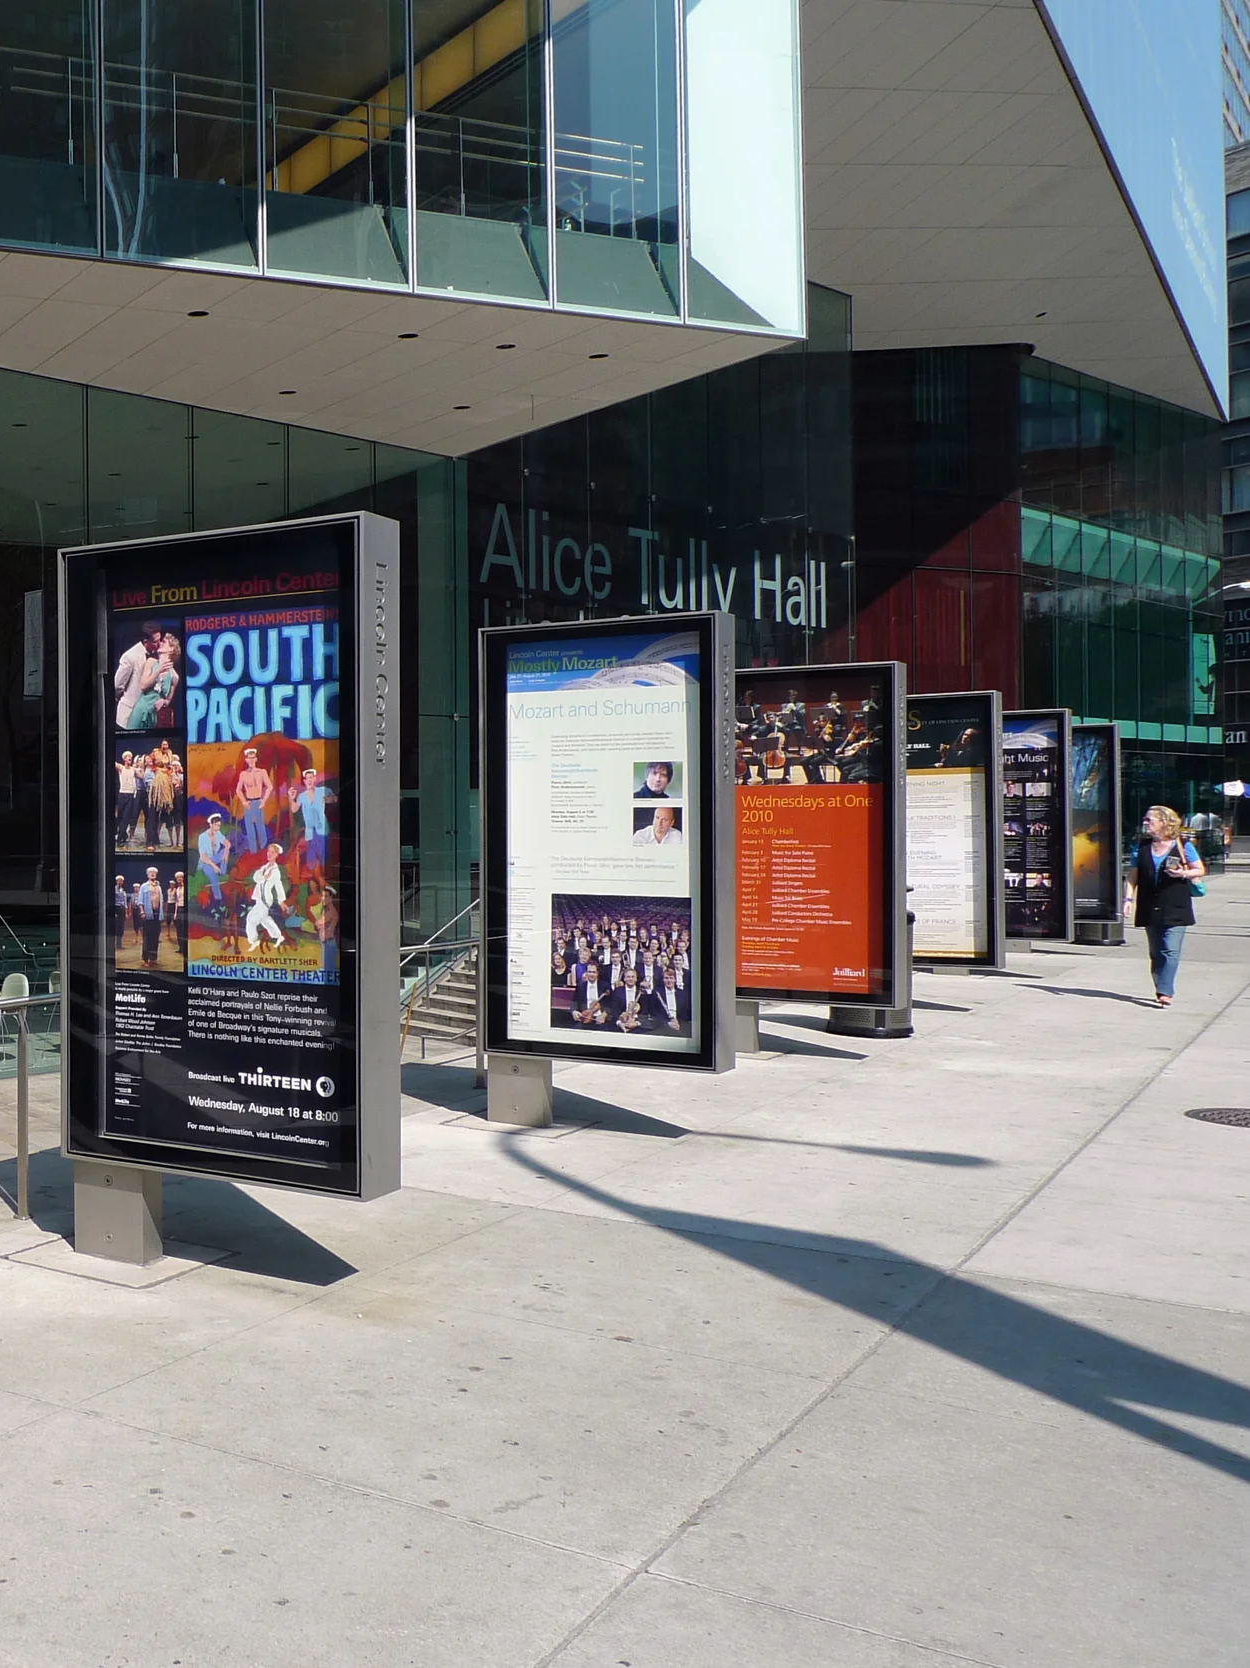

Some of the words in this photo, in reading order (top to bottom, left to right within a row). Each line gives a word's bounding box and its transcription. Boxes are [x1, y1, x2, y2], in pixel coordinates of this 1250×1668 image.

[479, 502, 612, 600] Alice
[628, 526, 737, 614] Tully
[754, 550, 827, 629] Hall
[112, 588, 147, 608] Live
[151, 585, 197, 604] From
[202, 576, 270, 600] Lincoln
[185, 615, 236, 632] RODGERS
[239, 615, 247, 626] &
[375, 562, 389, 666] Lincoln
[186, 622, 339, 687] SOUTH
[510, 658, 560, 675] Mostly
[562, 656, 618, 671] Mozart
[186, 680, 340, 743] PACIFIC
[510, 702, 564, 720] Mozart
[568, 701, 598, 717] and
[603, 698, 692, 716] Schumann
[376, 673, 389, 769] Center
[1018, 752, 1049, 763] Music
[741, 794, 825, 811] Wednesdays
[828, 795, 841, 808] at
[844, 794, 873, 808] One
[741, 810, 774, 823] 2010
[742, 827, 760, 835] Alice
[762, 827, 777, 837] Tully
[779, 827, 794, 835] Hall
[212, 954, 244, 963] DIRECTED
[247, 955, 256, 963] BY
[259, 956, 297, 966] BARTLETT
[300, 957, 318, 966] SHER
[191, 964, 237, 977] LINCOLN
[241, 966, 288, 980] CENTER
[292, 969, 340, 983] THEATER
[115, 993, 146, 1003] MetLife
[187, 986, 201, 994] Kelli
[202, 986, 225, 997] O'Hara
[226, 989, 239, 997] and
[241, 989, 259, 999] Paulo
[260, 991, 276, 1000] Szot
[277, 993, 301, 1003] reprise
[302, 993, 319, 1003] their
[187, 998, 220, 1007] acclaimed
[221, 1000, 254, 1010] portrayals
[264, 1003, 283, 1012] Nellie
[284, 1004, 313, 1014] Forbush
[314, 1006, 328, 1014] and
[188, 1008, 206, 1017] Emile
[207, 1009, 216, 1018] de
[217, 1011, 242, 1021] Becque
[243, 1012, 250, 1020] in
[251, 1012, 264, 1021] this
[265, 1013, 312, 1027] Tony-winning
[313, 1018, 336, 1028] revival
[187, 1019, 195, 1027] of
[210, 1020, 217, 1029] of
[218, 1021, 256, 1033] Broadway's
[257, 1025, 289, 1036] signature
[290, 1028, 323, 1038] musicals.
[187, 1030, 206, 1039] There
[207, 1031, 213, 1040] is
[214, 1032, 239, 1043] nothing
[240, 1034, 252, 1043] like
[254, 1035, 266, 1044] this
[267, 1036, 303, 1048] enchanted
[305, 1040, 335, 1051] evening!
[188, 1071, 221, 1083] Broadcast
[222, 1075, 235, 1084] live
[188, 1095, 246, 1114] Wednesday,
[248, 1102, 284, 1117] August
[287, 1106, 300, 1118] 18
[302, 1109, 313, 1120] at
[315, 1111, 339, 1123] 8:00
[187, 1121, 197, 1130] For
[199, 1124, 216, 1133] more
[216, 1126, 255, 1138] information,
[256, 1130, 270, 1139] visit
[271, 1132, 330, 1148] LincolnCenter.org
